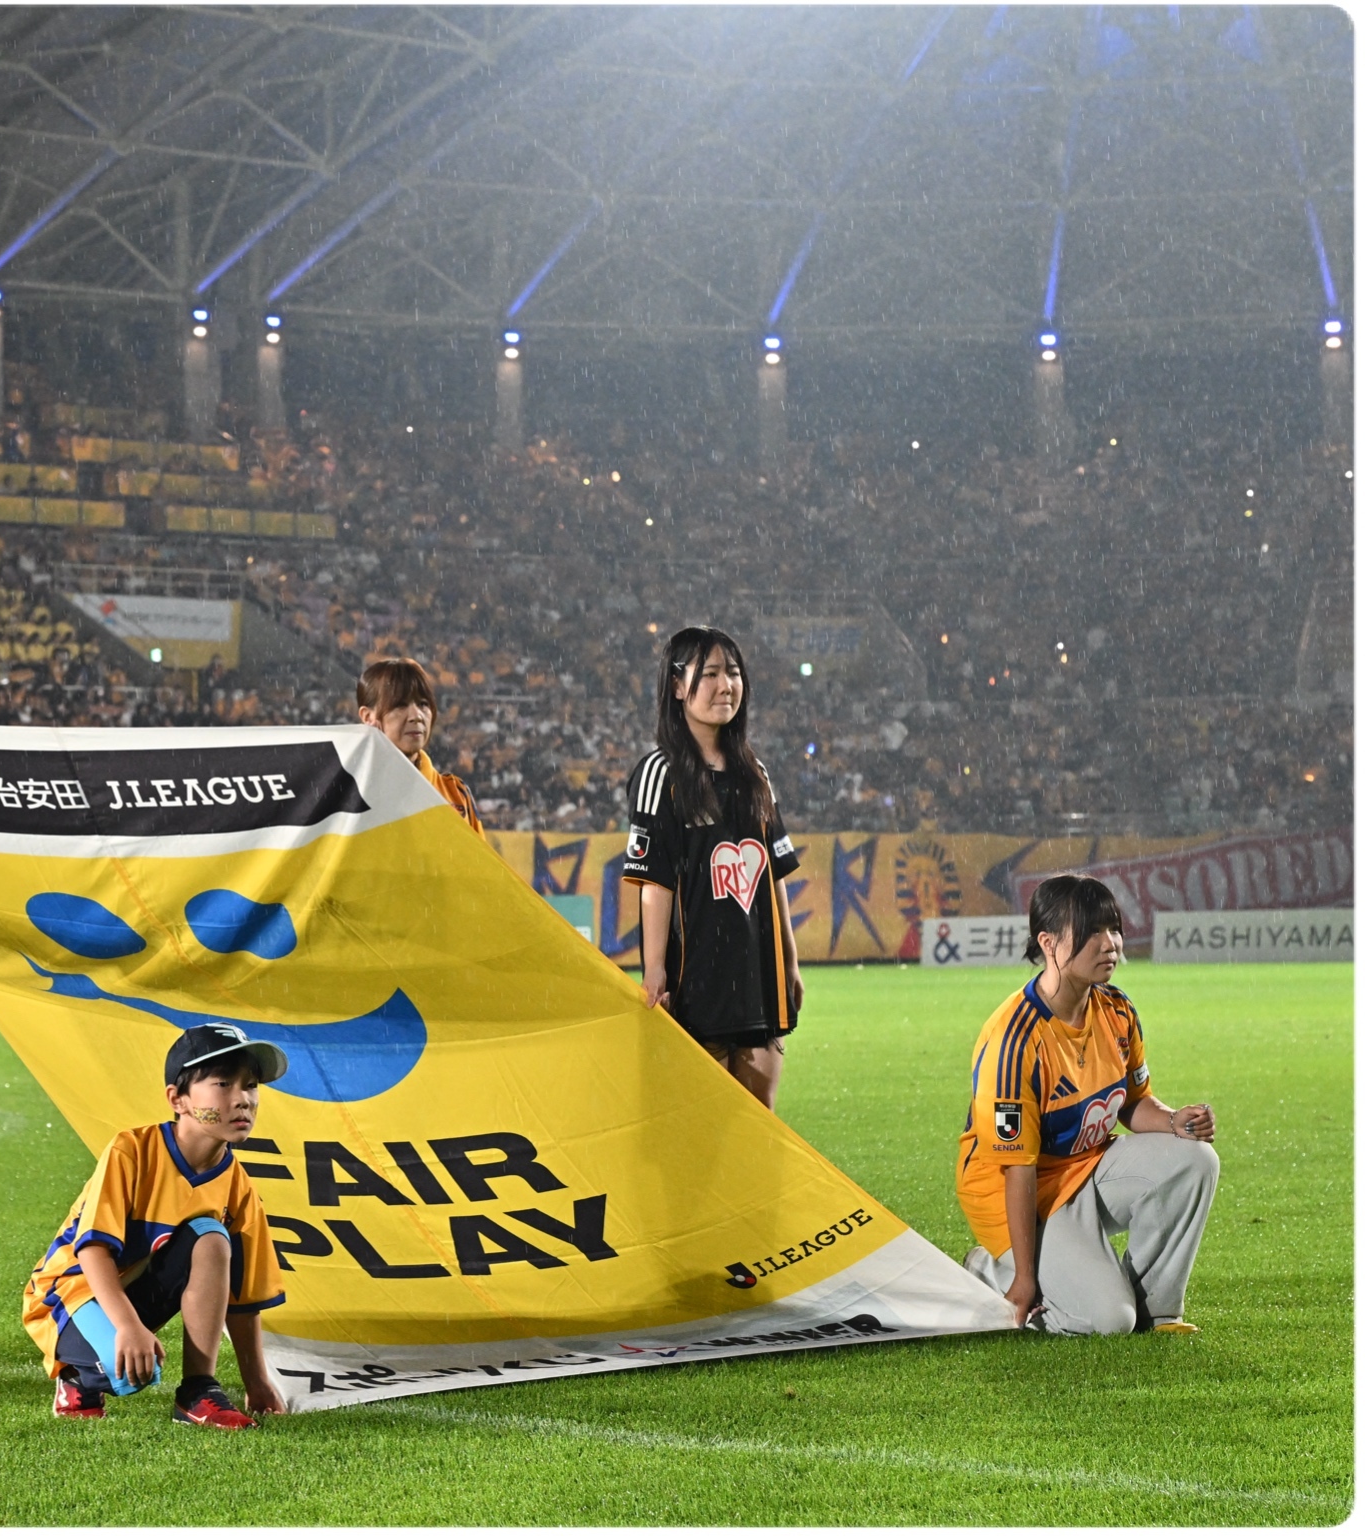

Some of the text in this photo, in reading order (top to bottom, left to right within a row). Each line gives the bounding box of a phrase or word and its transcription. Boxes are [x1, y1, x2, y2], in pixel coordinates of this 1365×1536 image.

[106, 773, 295, 810] J.LEAGUE
[713, 861, 751, 898] IRIS
[1101, 834, 1355, 929] NSORED
[1165, 924, 1355, 950] KASHIYAMA
[992, 1143, 1025, 1152] SENDAI
[1073, 1113, 1113, 1154] IRIS
[266, 1193, 620, 1280] PLAY
[752, 1208, 873, 1278] J.LEAGUE
